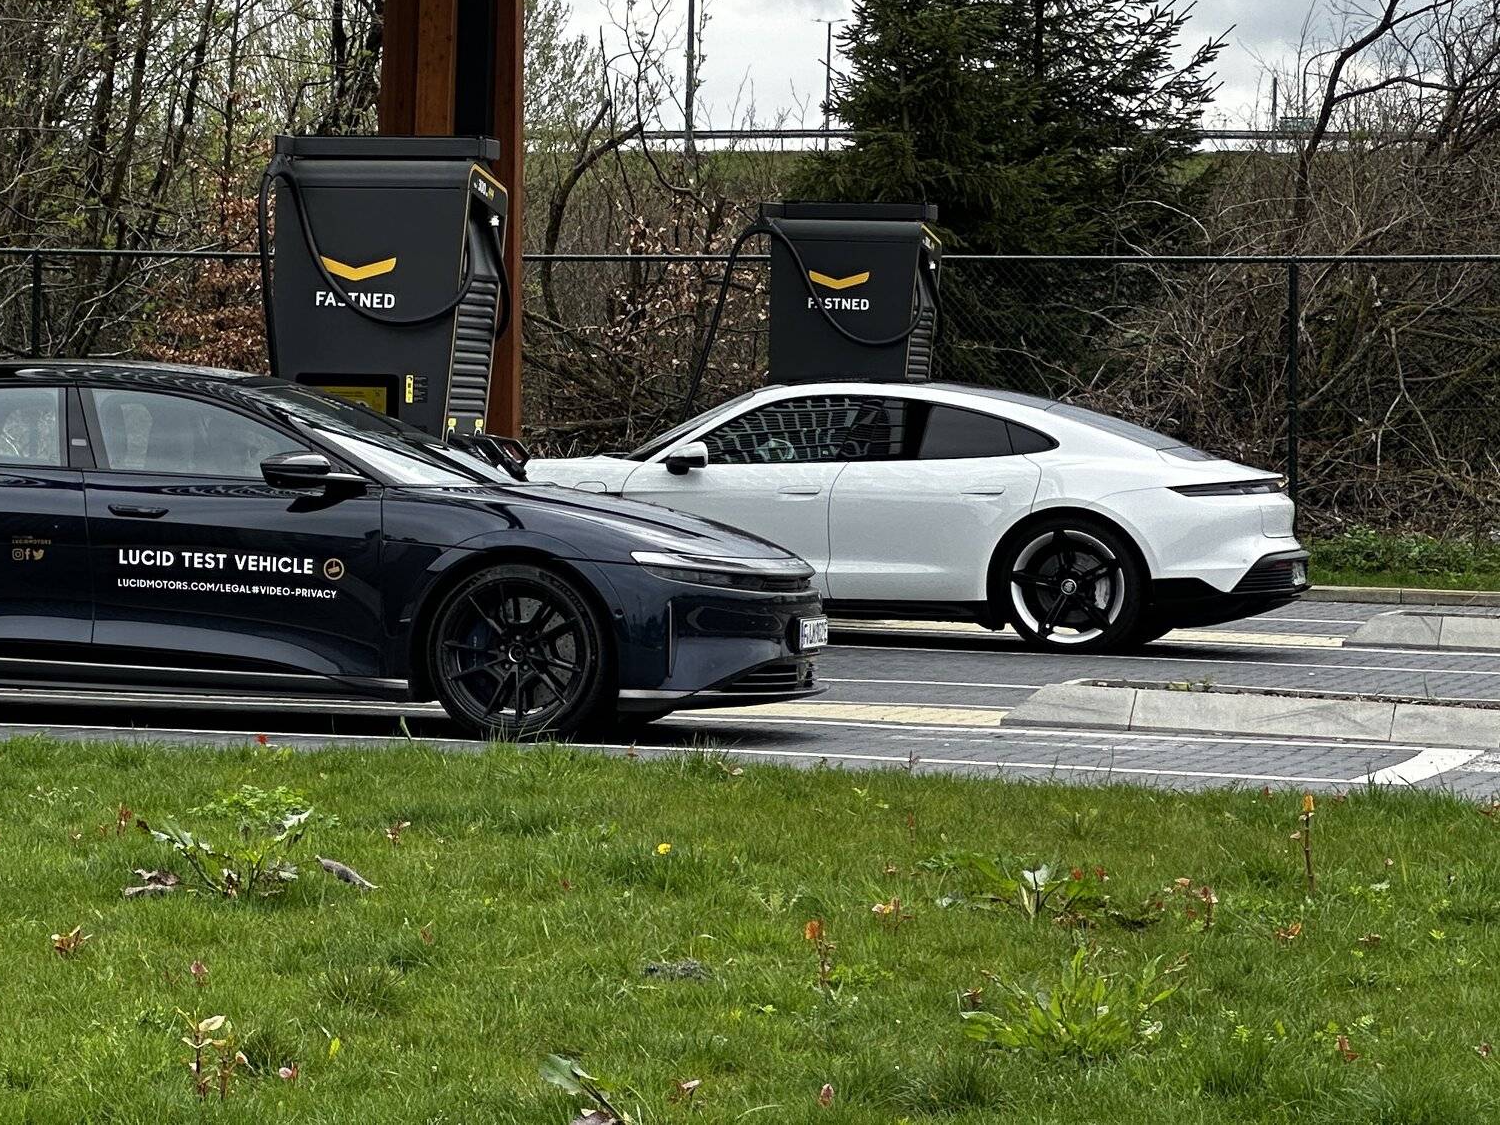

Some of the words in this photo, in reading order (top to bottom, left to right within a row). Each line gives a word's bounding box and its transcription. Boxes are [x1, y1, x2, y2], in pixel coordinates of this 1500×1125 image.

[315, 291, 396, 309] FATNED
[118, 549, 175, 568] LUCID
[181, 551, 228, 569] TEST
[234, 554, 314, 574] VEHICLE
[117, 578, 338, 599] LUCIDMOTORS.COM/LEGAL#VIDEO-PRIVACY
